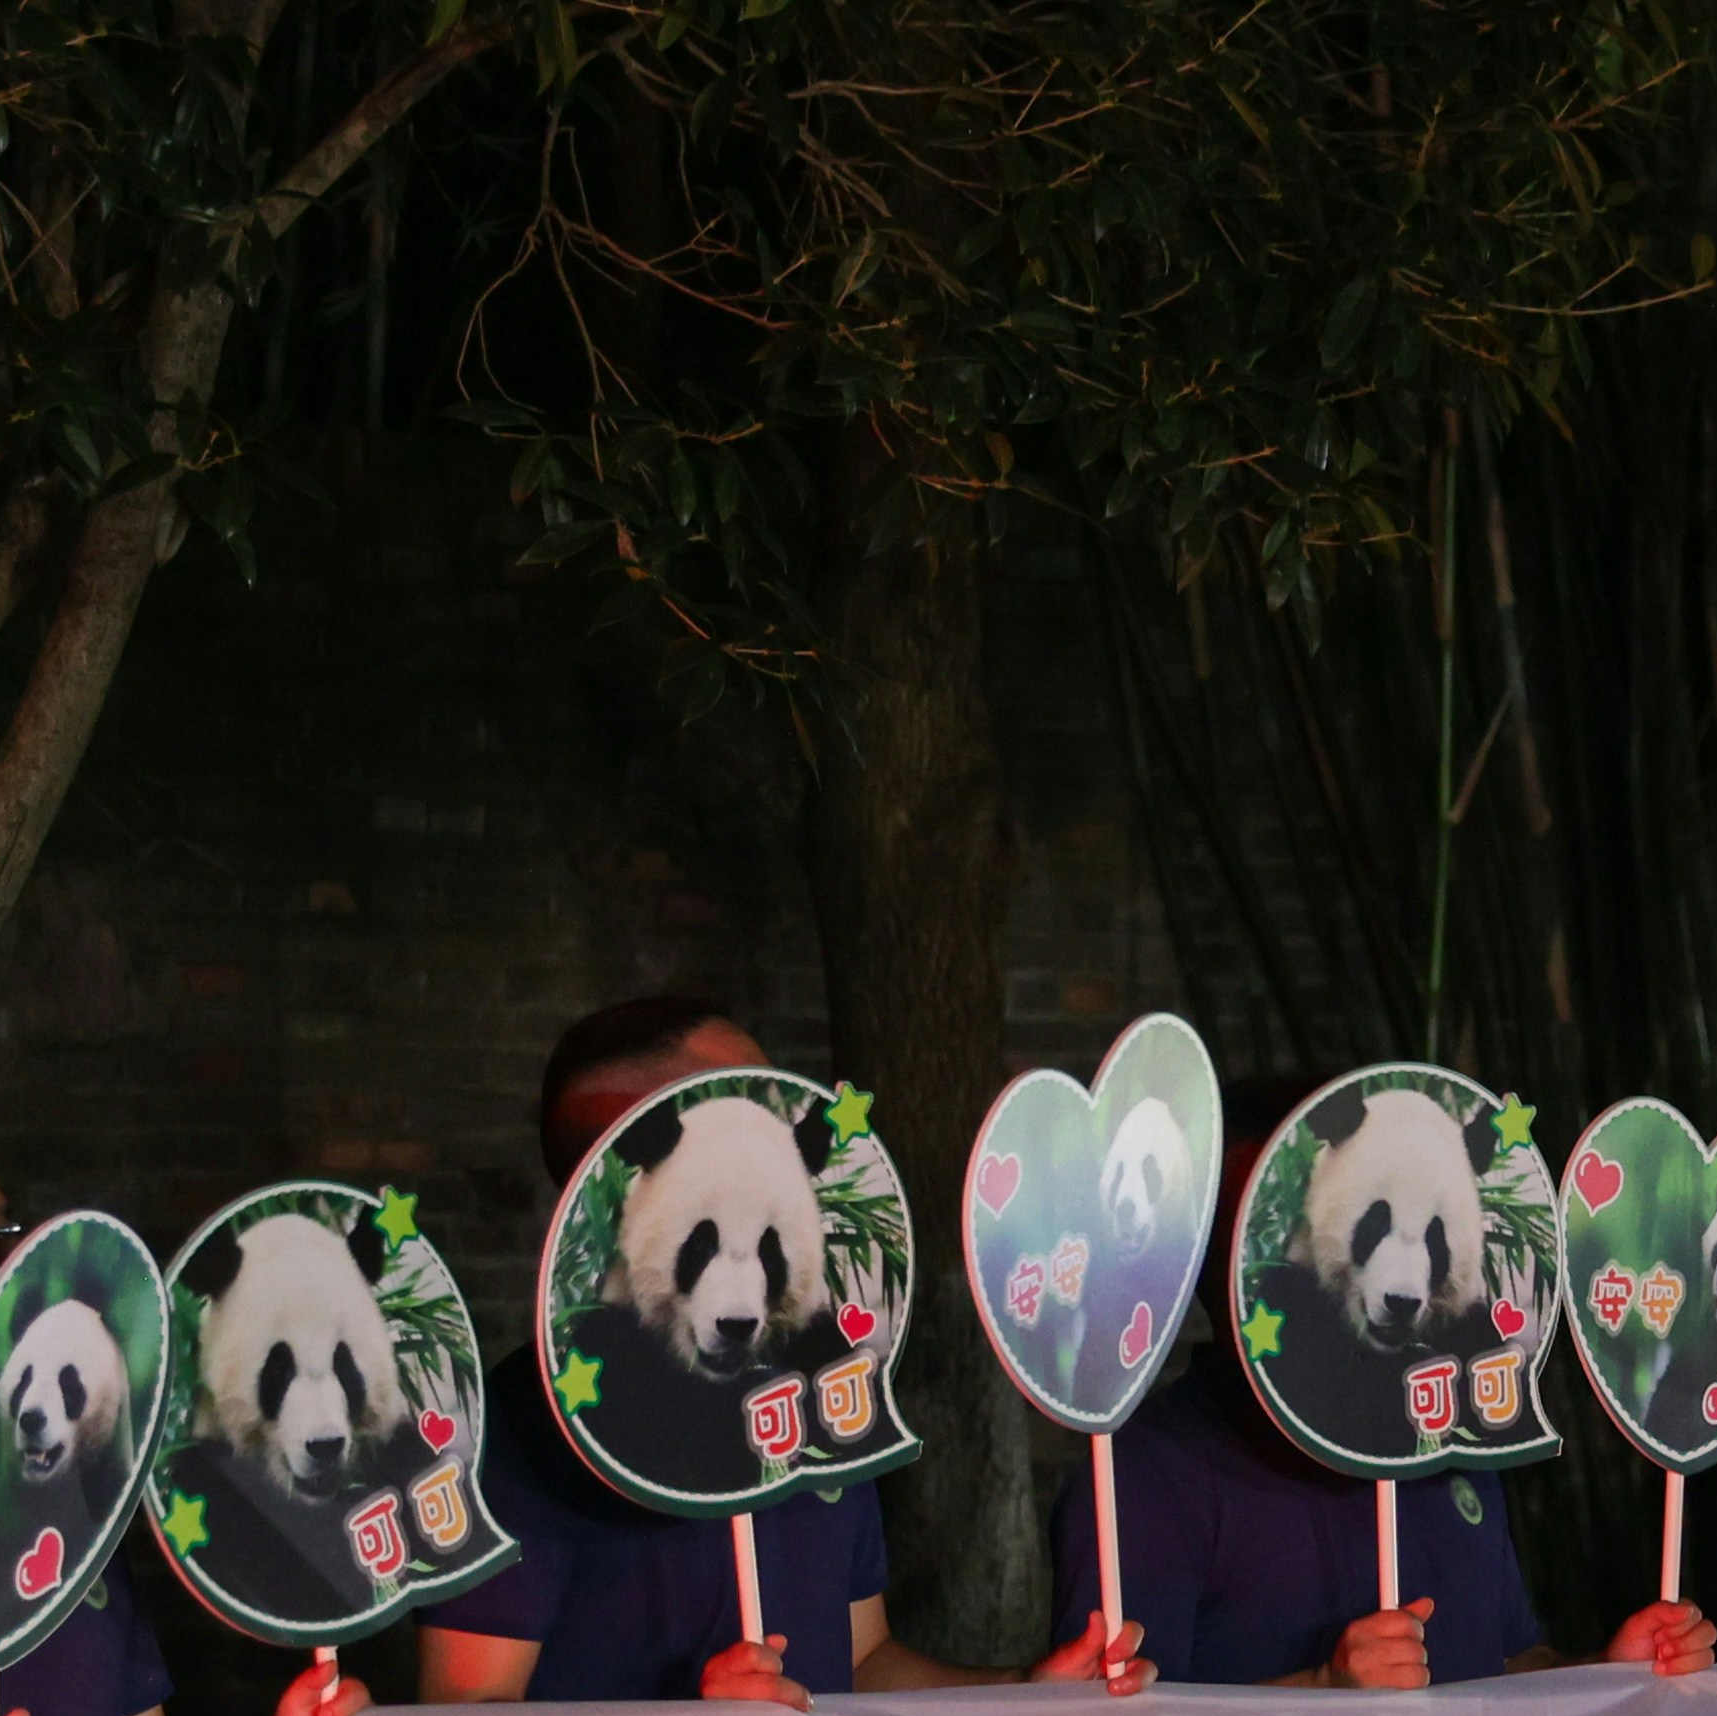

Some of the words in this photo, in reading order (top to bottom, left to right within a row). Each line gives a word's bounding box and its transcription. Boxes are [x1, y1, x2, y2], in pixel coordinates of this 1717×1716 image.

[1009, 1236, 1089, 1322] 安安
[1589, 1262, 1682, 1335] 安安
[750, 1357, 873, 1459] 可可
[1407, 1348, 1523, 1434] 可可
[349, 1457, 468, 1577] 可可
